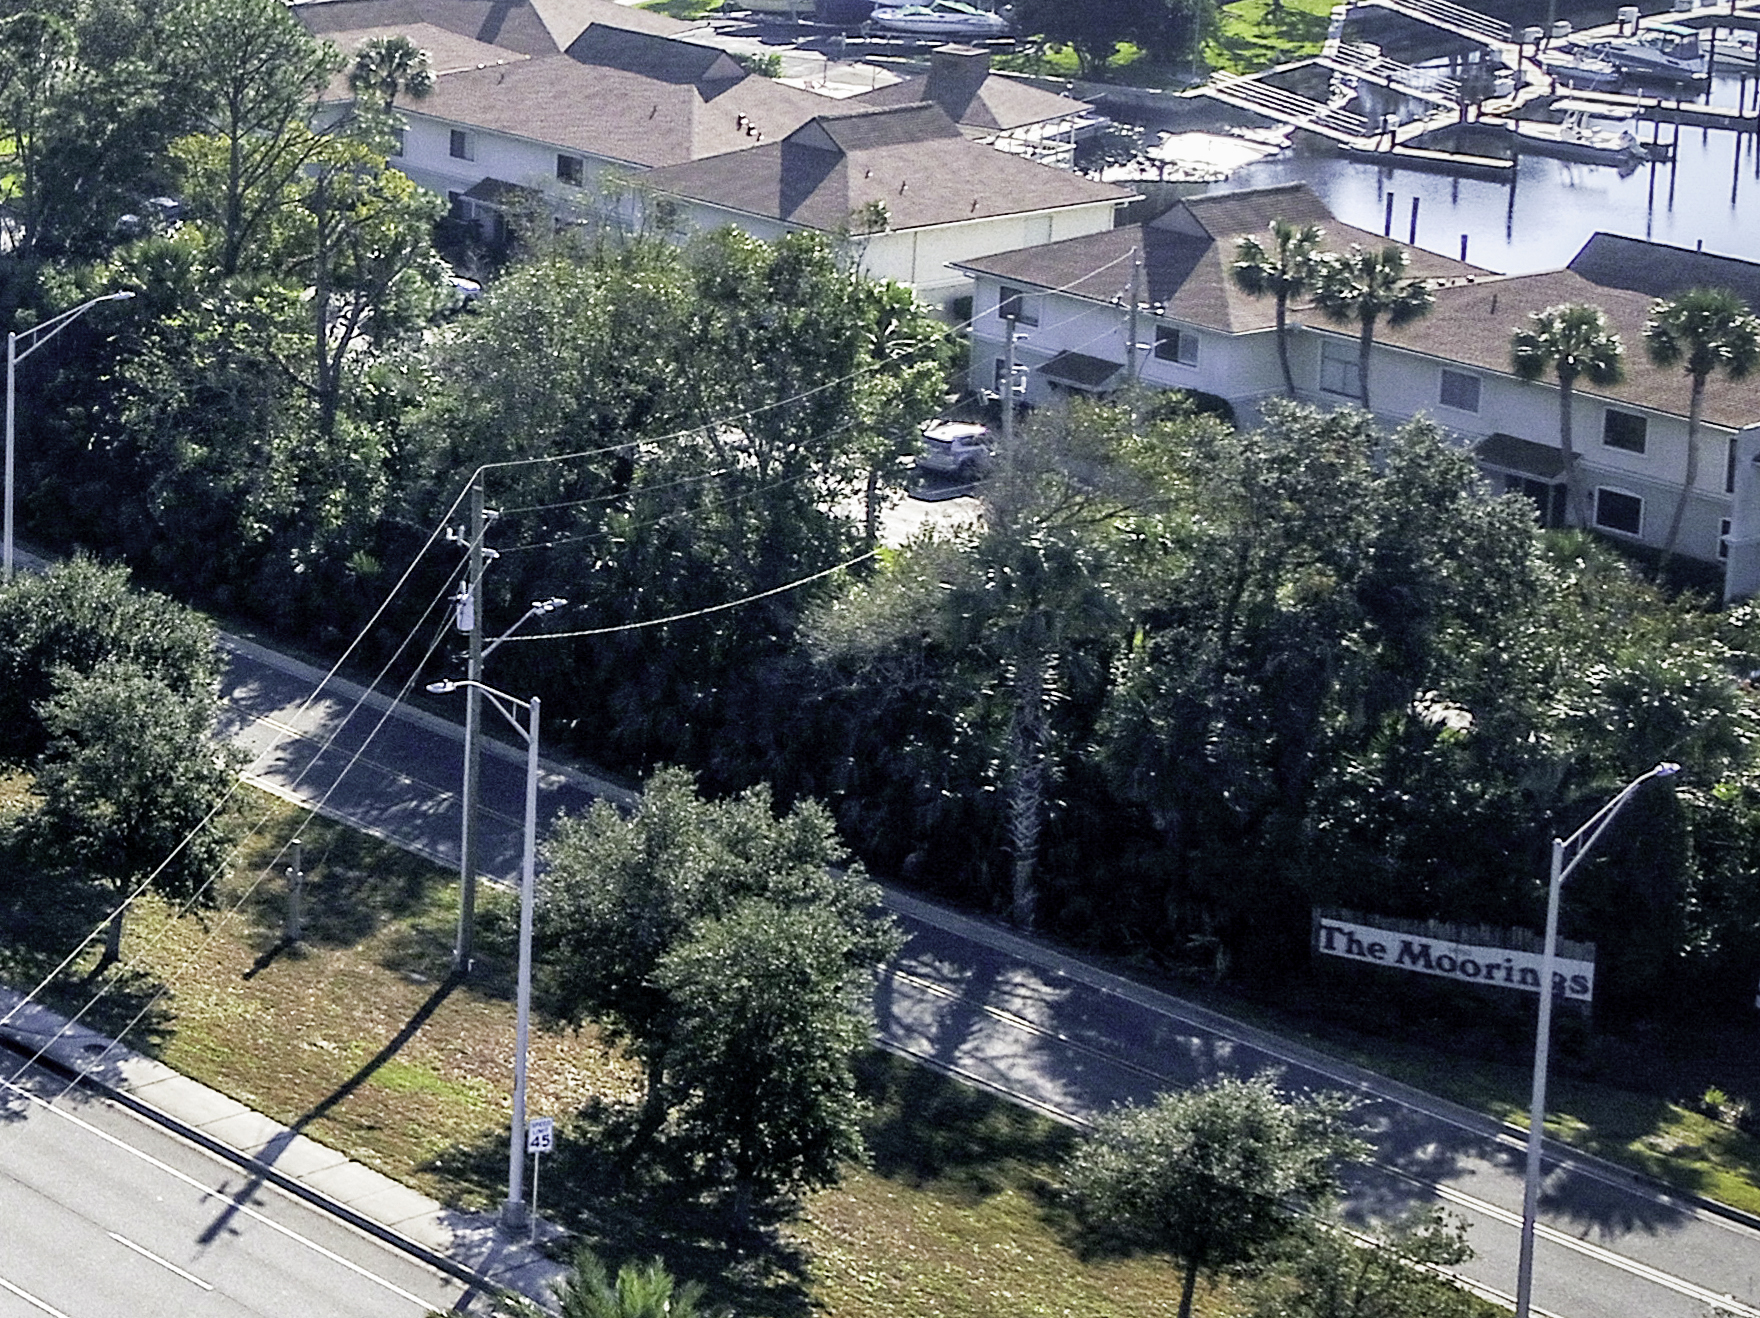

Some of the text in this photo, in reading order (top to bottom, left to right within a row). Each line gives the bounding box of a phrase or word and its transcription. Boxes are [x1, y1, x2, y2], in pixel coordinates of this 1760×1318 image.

[1320, 925, 1387, 960] The
[532, 1120, 551, 1128] SPEED
[530, 1134, 550, 1148] 45
